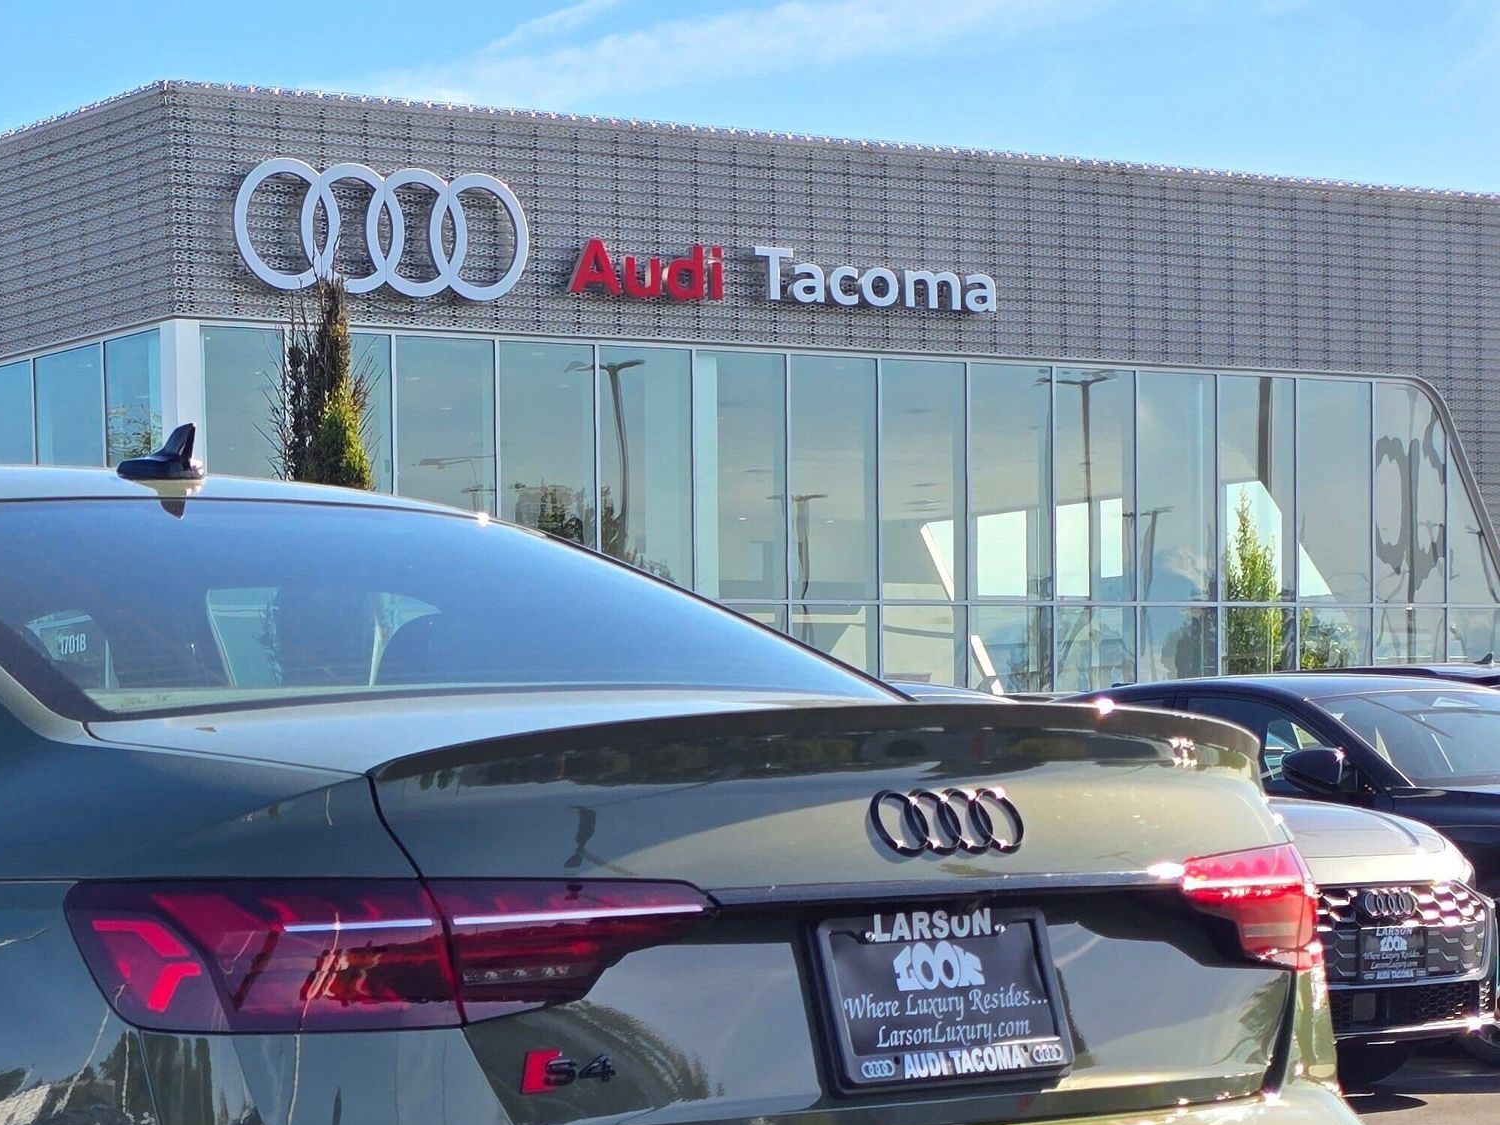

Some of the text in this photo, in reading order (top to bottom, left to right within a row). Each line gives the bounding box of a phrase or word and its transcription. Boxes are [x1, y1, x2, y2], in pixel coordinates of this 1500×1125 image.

[566, 237, 997, 313] Audi Tacoma
[873, 907, 992, 942] LARSON
[844, 983, 1049, 1021] Where Luxury Resides...
[876, 1018, 1032, 1048] LarsonLuxury.com
[543, 1054, 617, 1086] S4
[904, 1044, 1027, 1079] AUDI TACOMA
